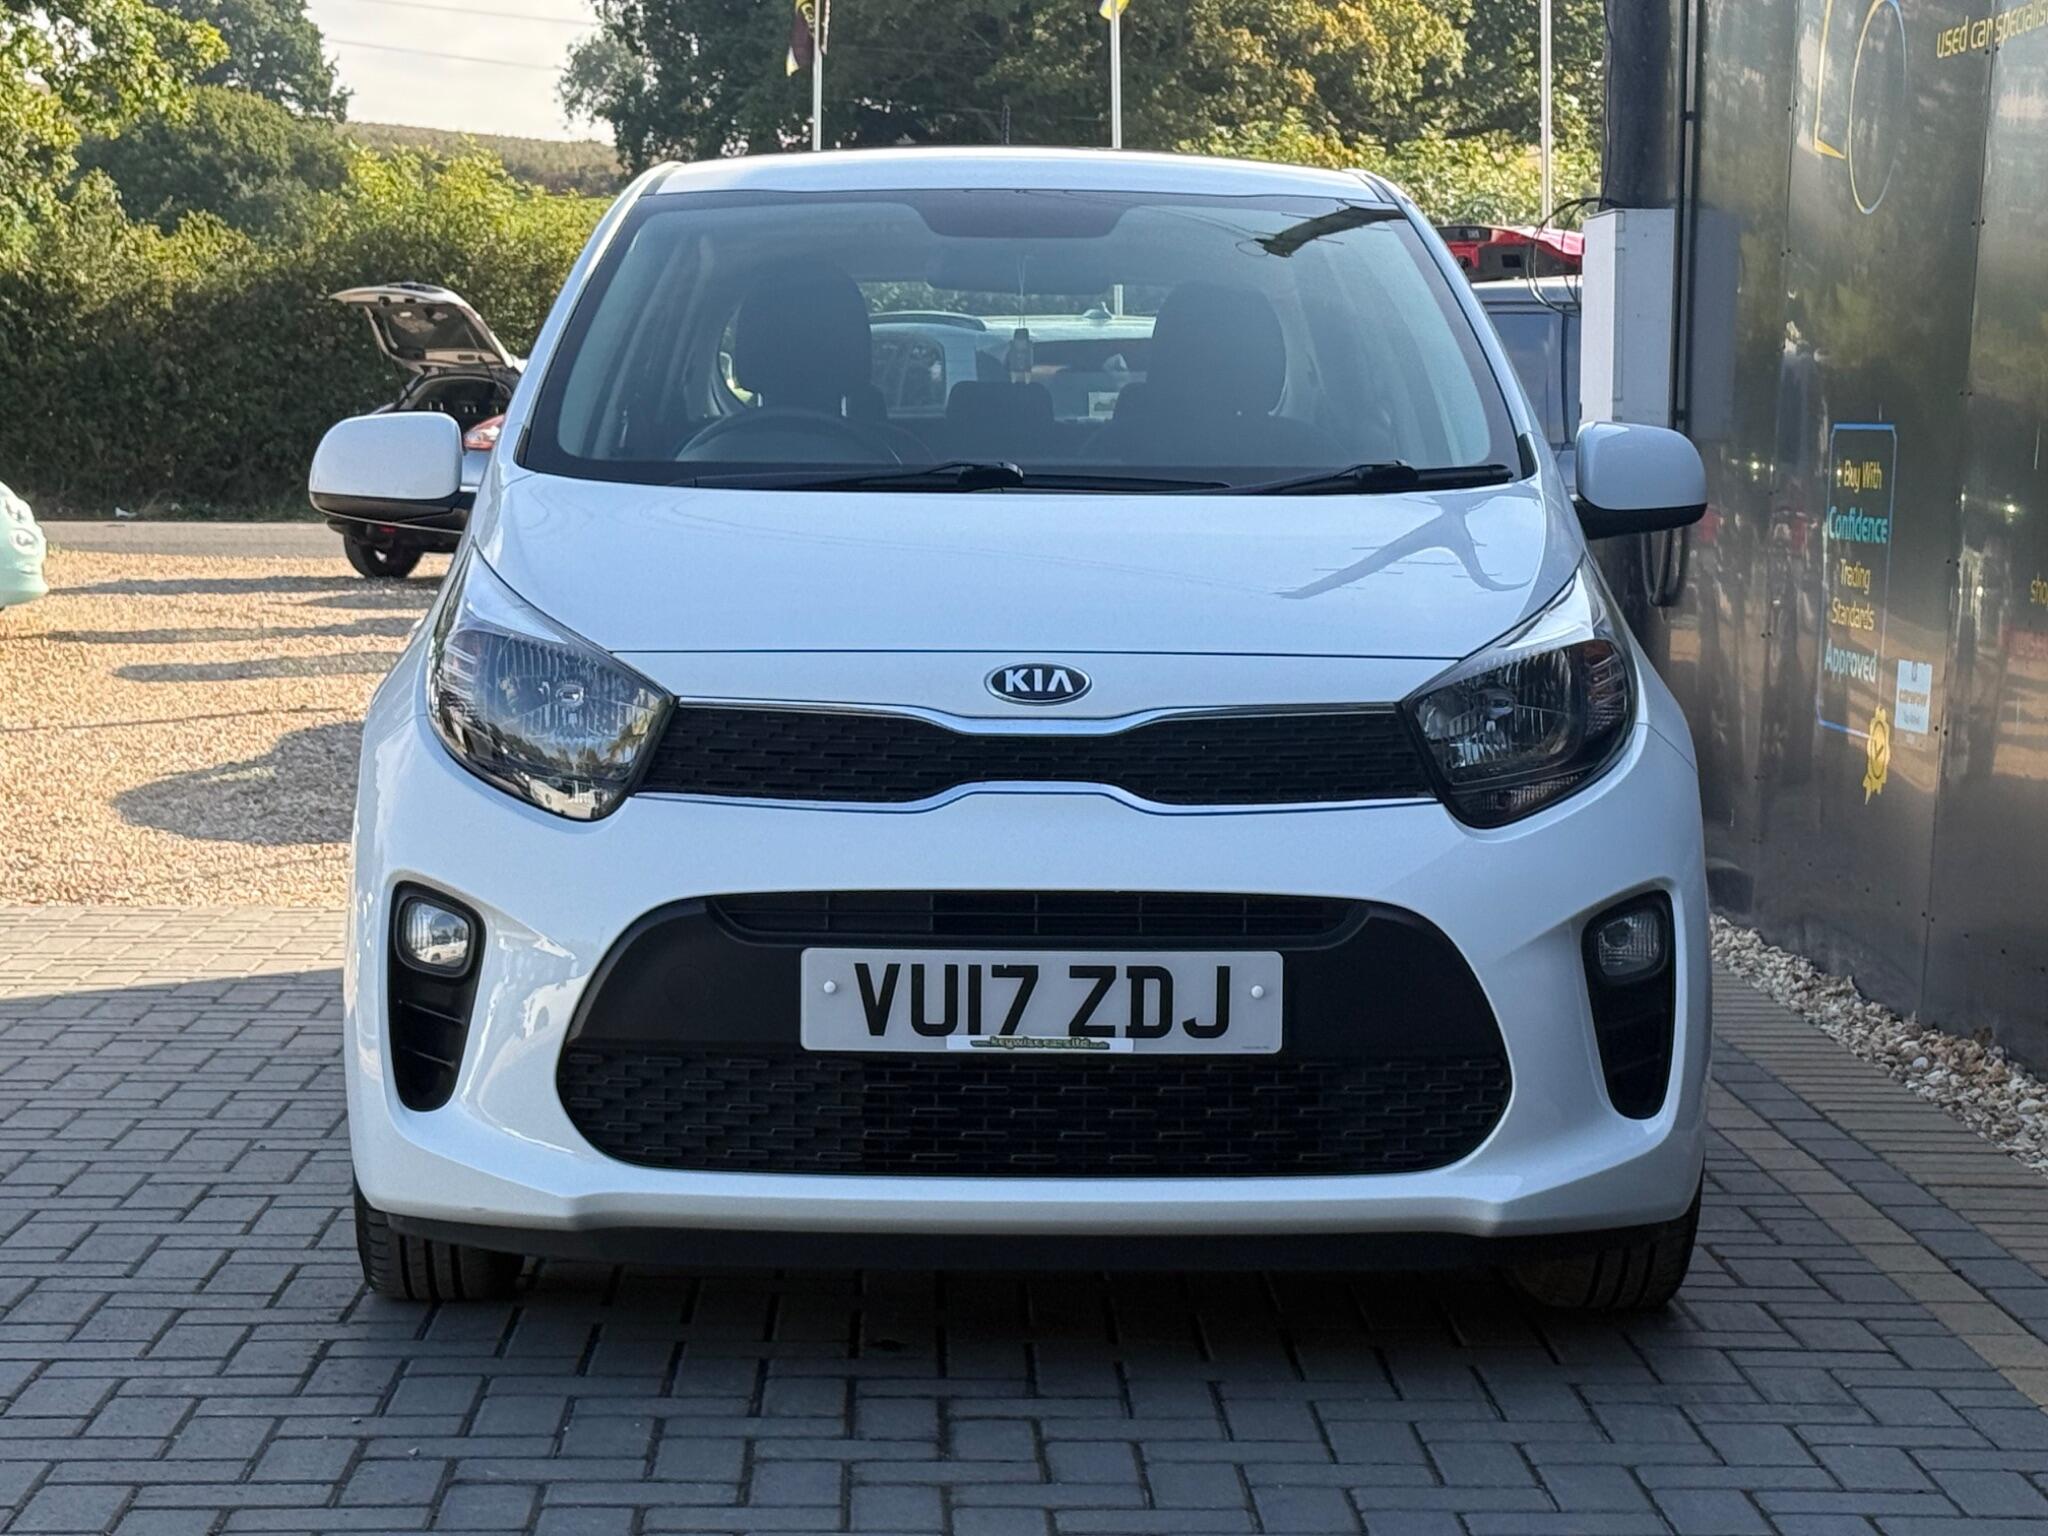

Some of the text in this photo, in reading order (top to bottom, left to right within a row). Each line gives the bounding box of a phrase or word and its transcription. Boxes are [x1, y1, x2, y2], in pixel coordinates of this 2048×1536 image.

[1937, 15, 1969, 58] used
[1970, 18, 1993, 49] car
[1843, 459, 1883, 493] Buy With
[1829, 505, 1889, 544] Confidence
[1840, 558, 1871, 595] Trading
[2031, 571, 2048, 611] sho
[1832, 597, 1875, 632] Standards
[1004, 668, 1074, 693] KIA
[1824, 638, 1877, 684] Approved
[854, 963, 1231, 1038] VU17 ZDJ
